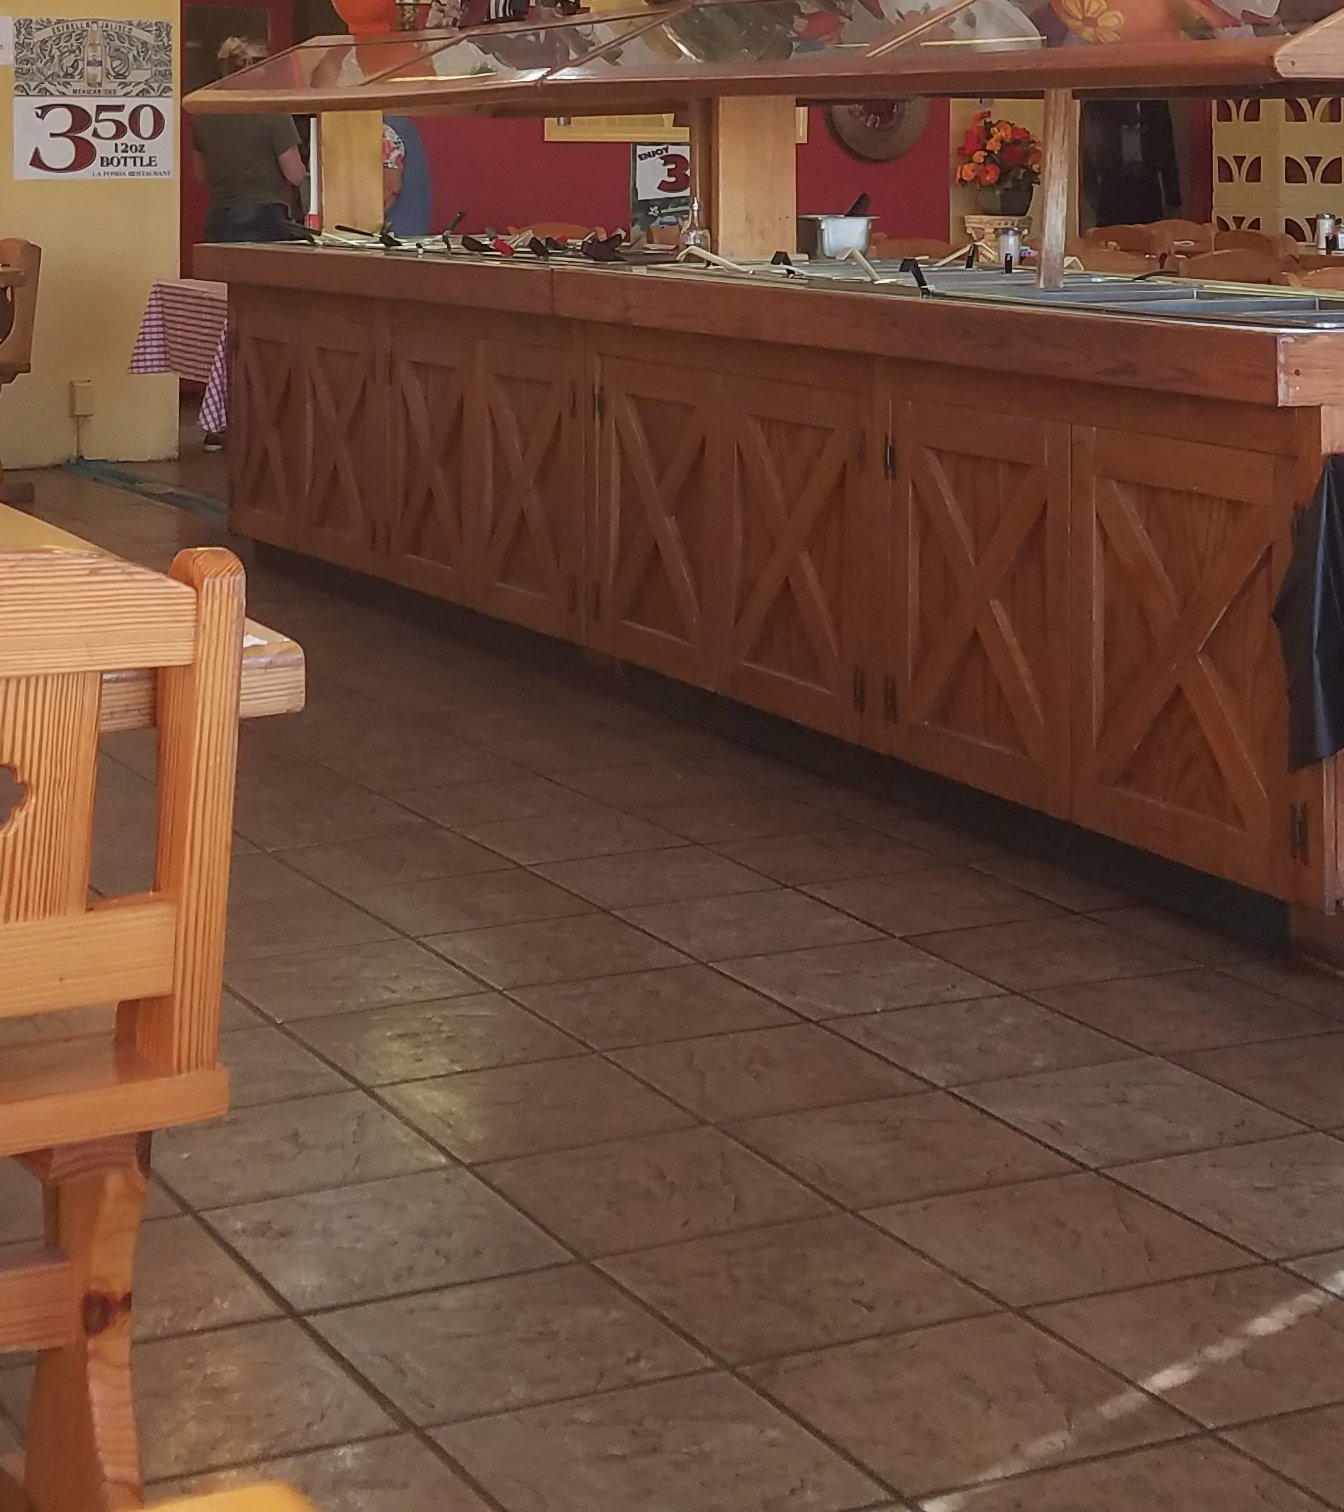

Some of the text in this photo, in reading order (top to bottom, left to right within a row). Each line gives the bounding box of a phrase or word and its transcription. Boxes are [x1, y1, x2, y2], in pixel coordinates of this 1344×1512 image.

[51, 21, 133, 35] ESTRELLA JALISCO
[114, 142, 145, 155] 12oz
[638, 147, 670, 161] ENJOY
[100, 156, 158, 169] BOTTLE
[657, 154, 690, 193] 3
